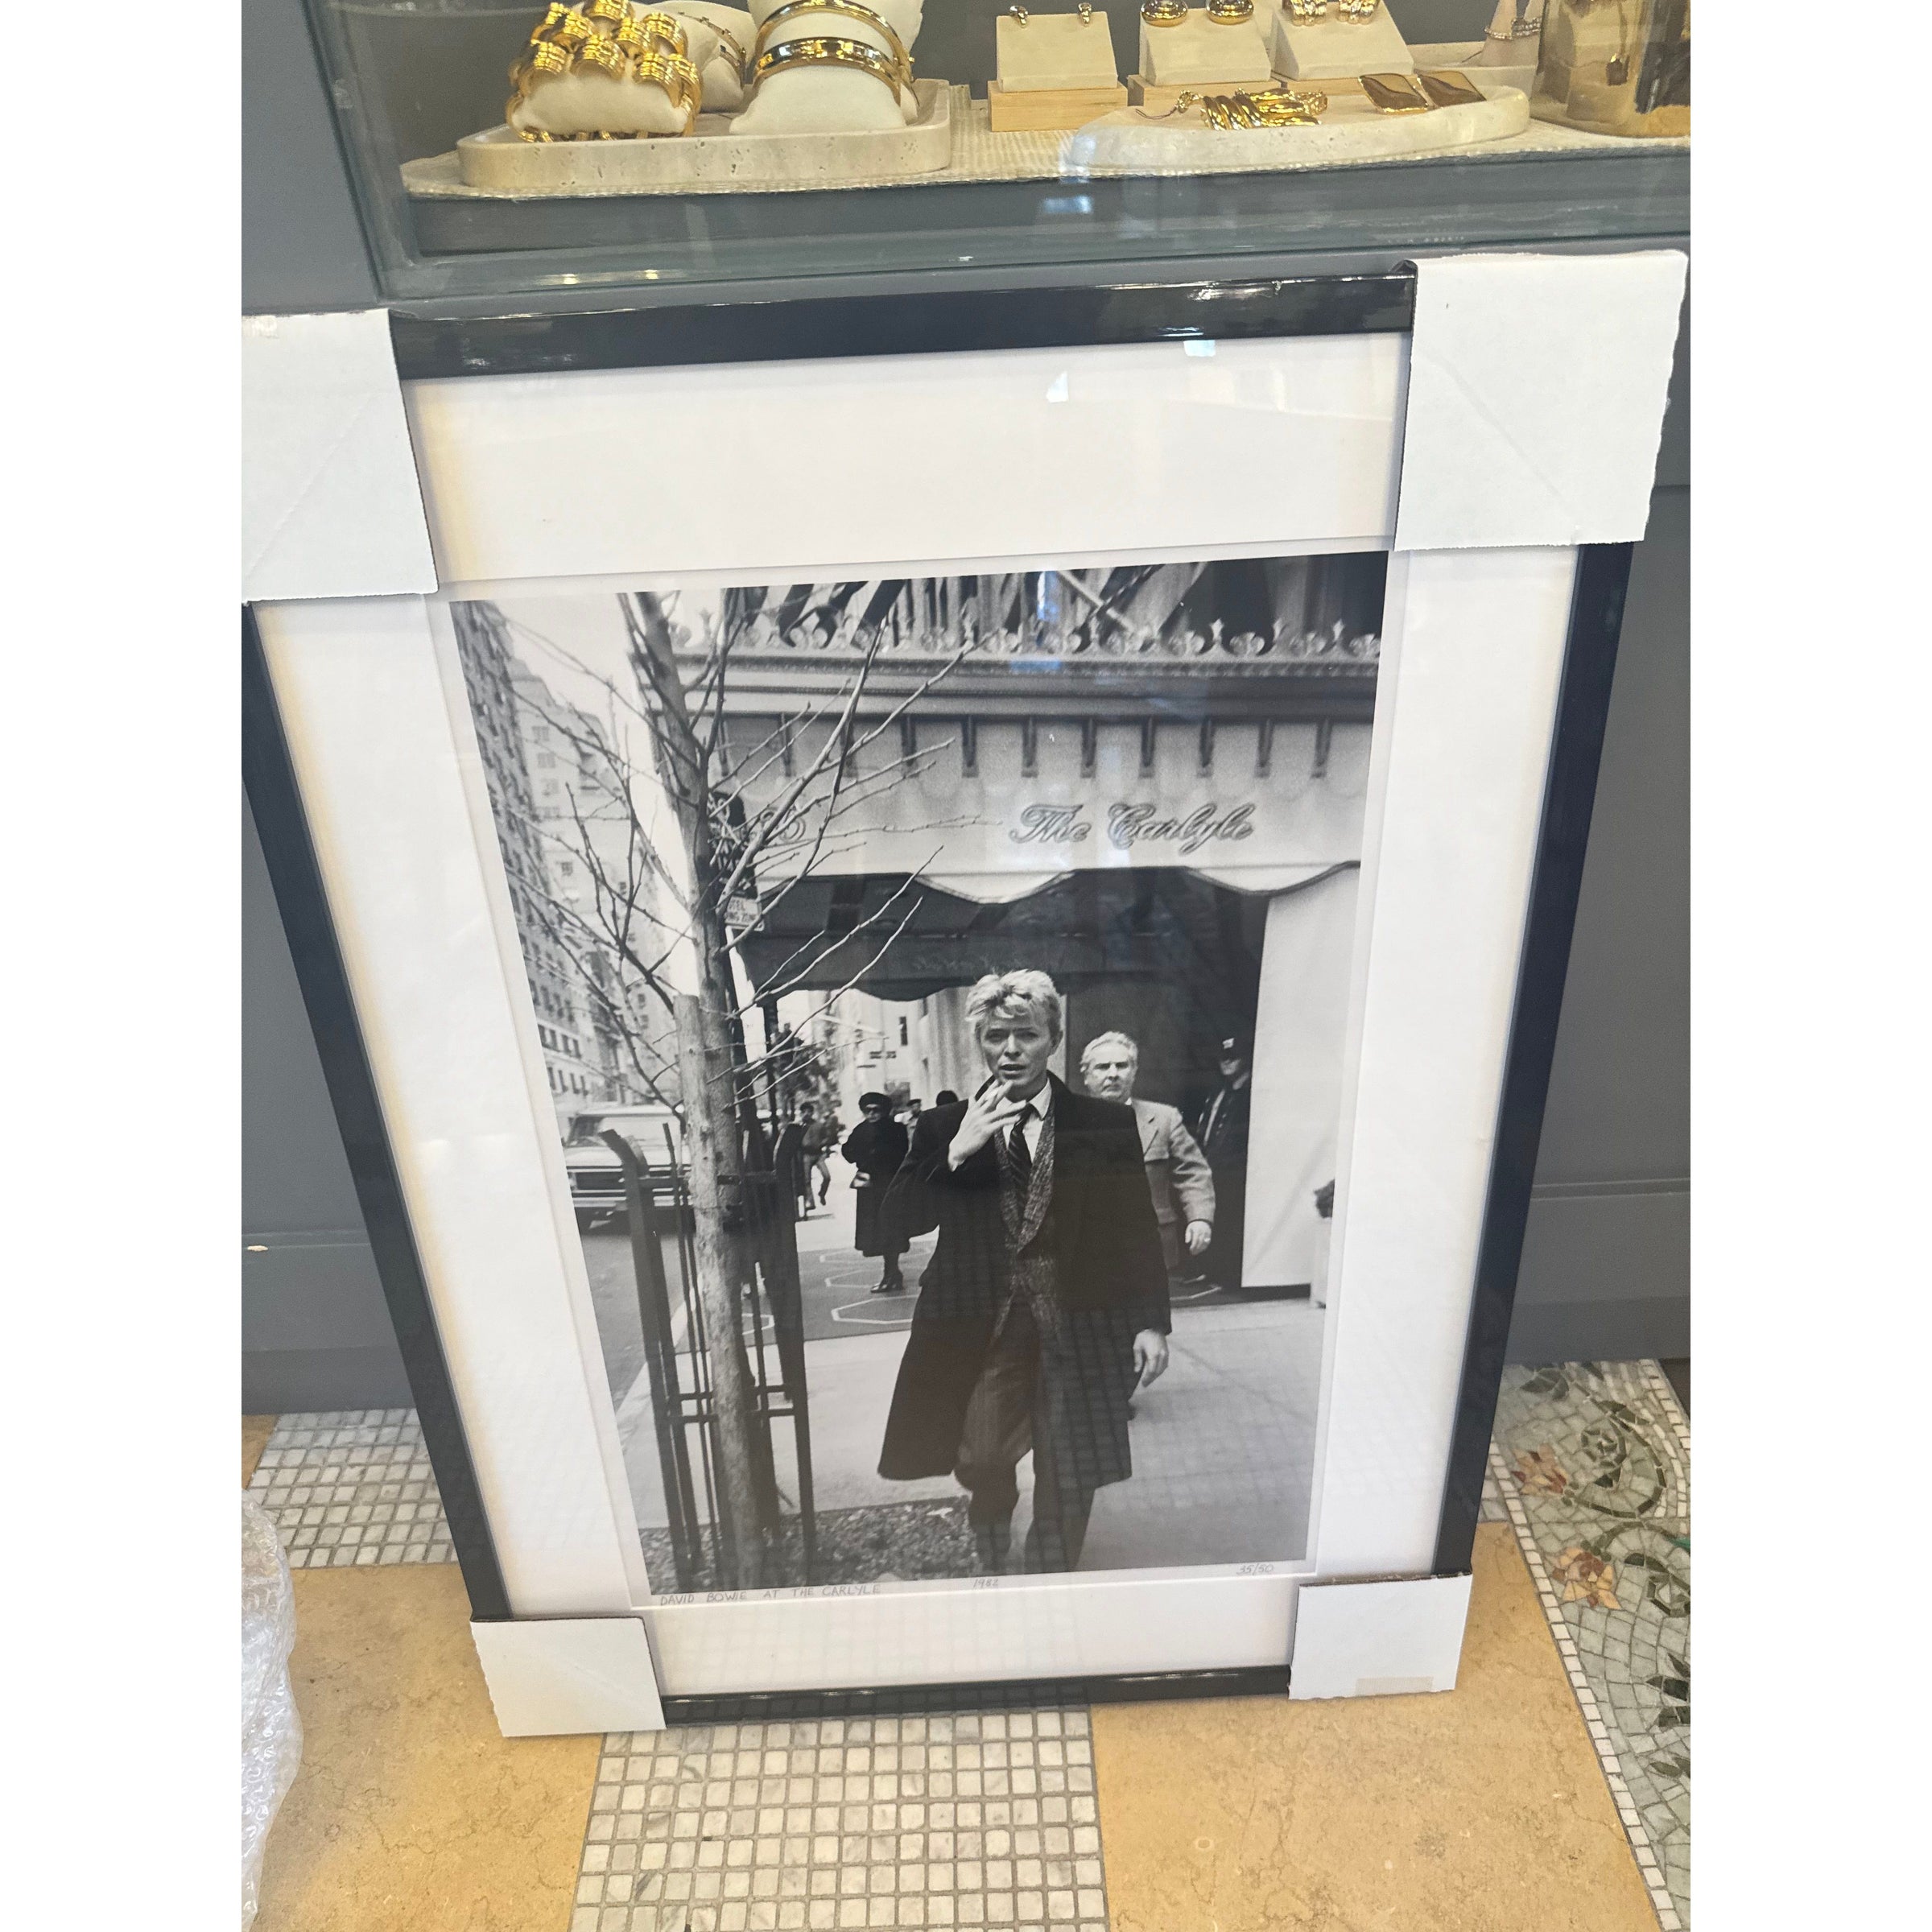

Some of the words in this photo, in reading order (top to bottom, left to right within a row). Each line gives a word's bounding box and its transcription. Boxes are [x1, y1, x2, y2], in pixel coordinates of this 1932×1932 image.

[1009, 804, 1092, 844] The
[1107, 803, 1256, 855] Carlyle
[1236, 1563, 1274, 1576] 35/50
[660, 1594, 694, 1606] DAVID
[706, 1591, 747, 1603] BOWIE
[763, 1588, 778, 1599] AT
[792, 1587, 814, 1597] THE
[822, 1583, 881, 1597] CARLYLE
